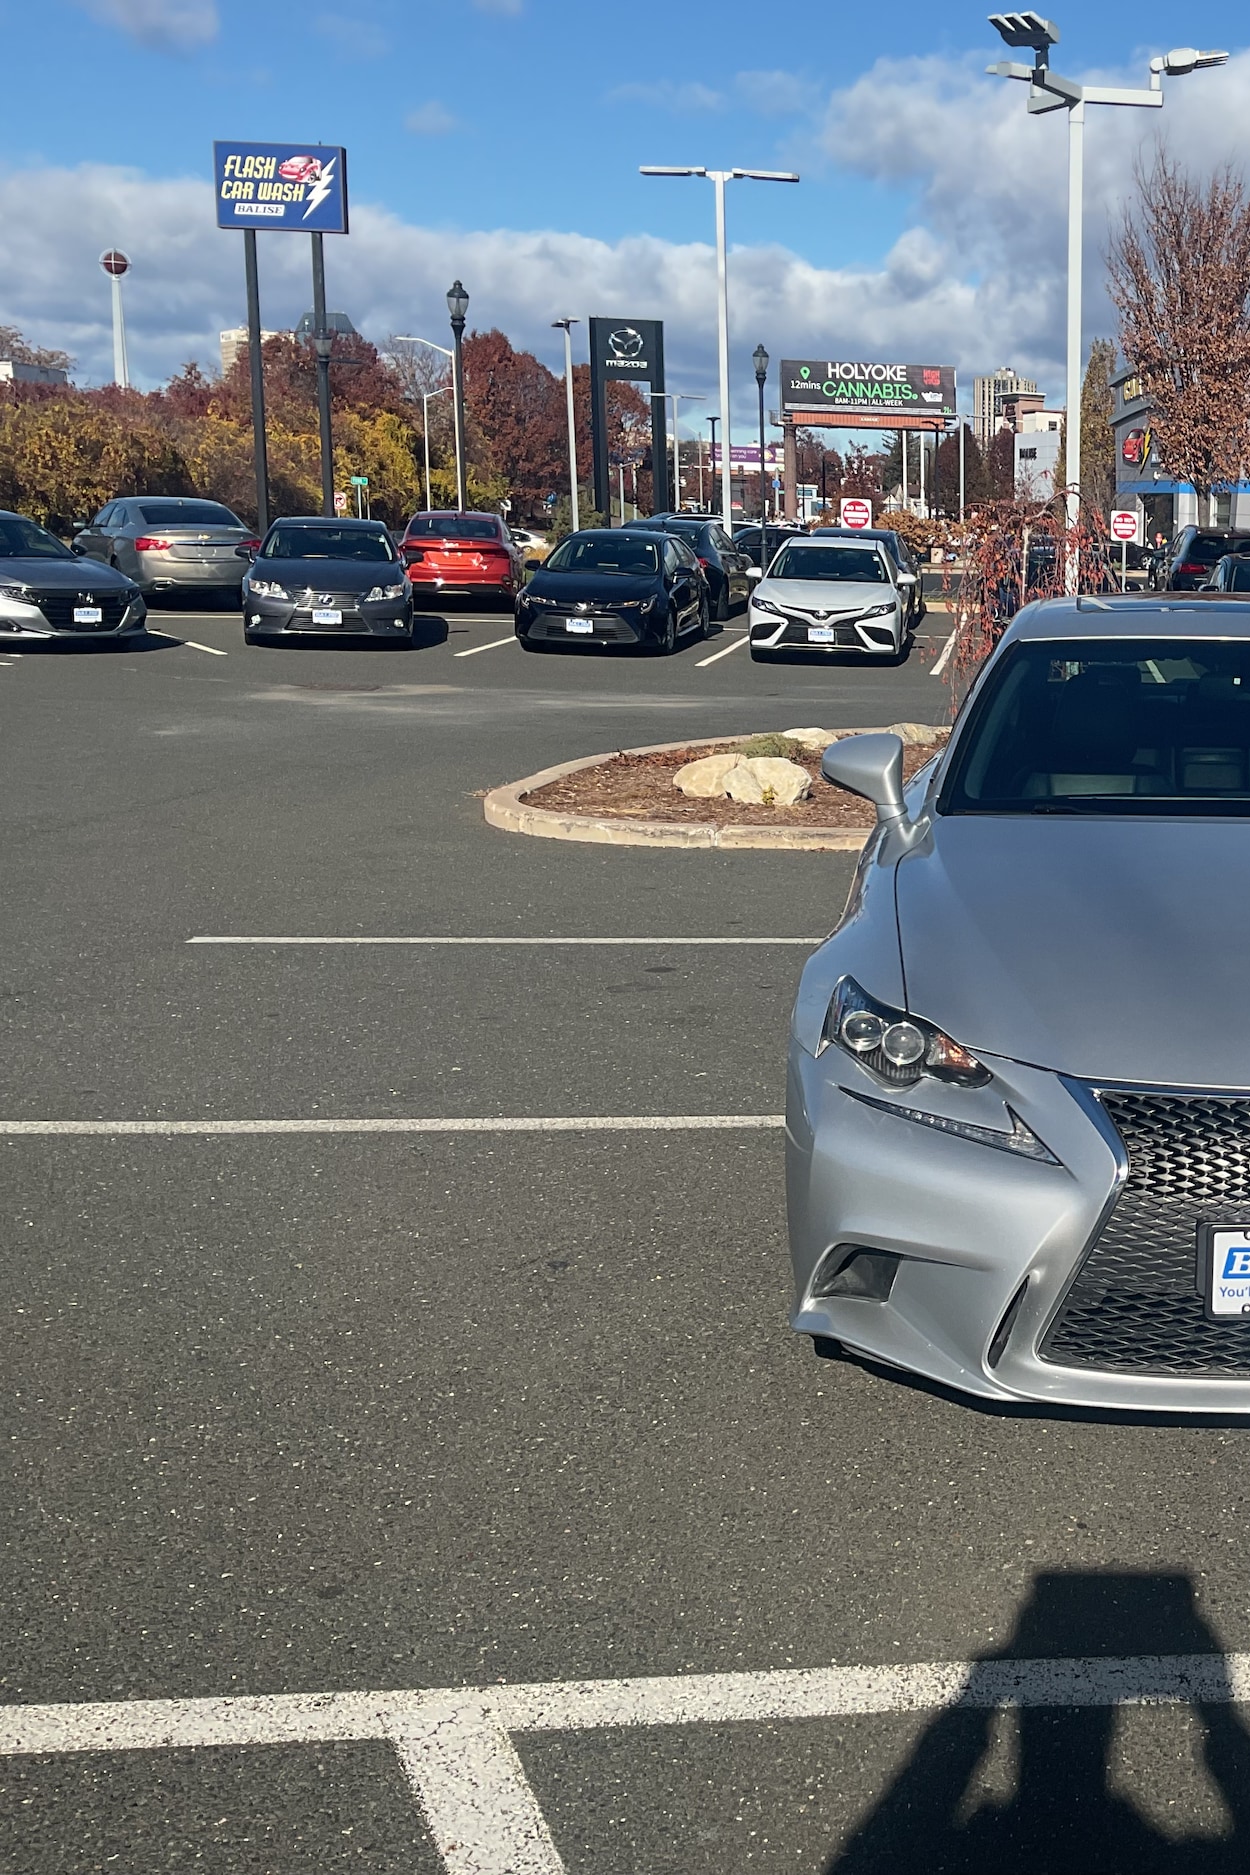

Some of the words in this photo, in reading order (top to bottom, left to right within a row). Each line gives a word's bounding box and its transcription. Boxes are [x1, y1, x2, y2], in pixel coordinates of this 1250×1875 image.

[224, 155, 277, 180] FLASH
[221, 180, 254, 200] CAR
[257, 182, 305, 202] WASH
[237, 205, 283, 214] BALISE
[605, 360, 648, 369] mazda
[827, 362, 907, 381] HOLYOKE
[790, 380, 821, 390] 12mins
[834, 398, 868, 406] 8AM-11PM
[871, 399, 903, 407] ALL-WEEK
